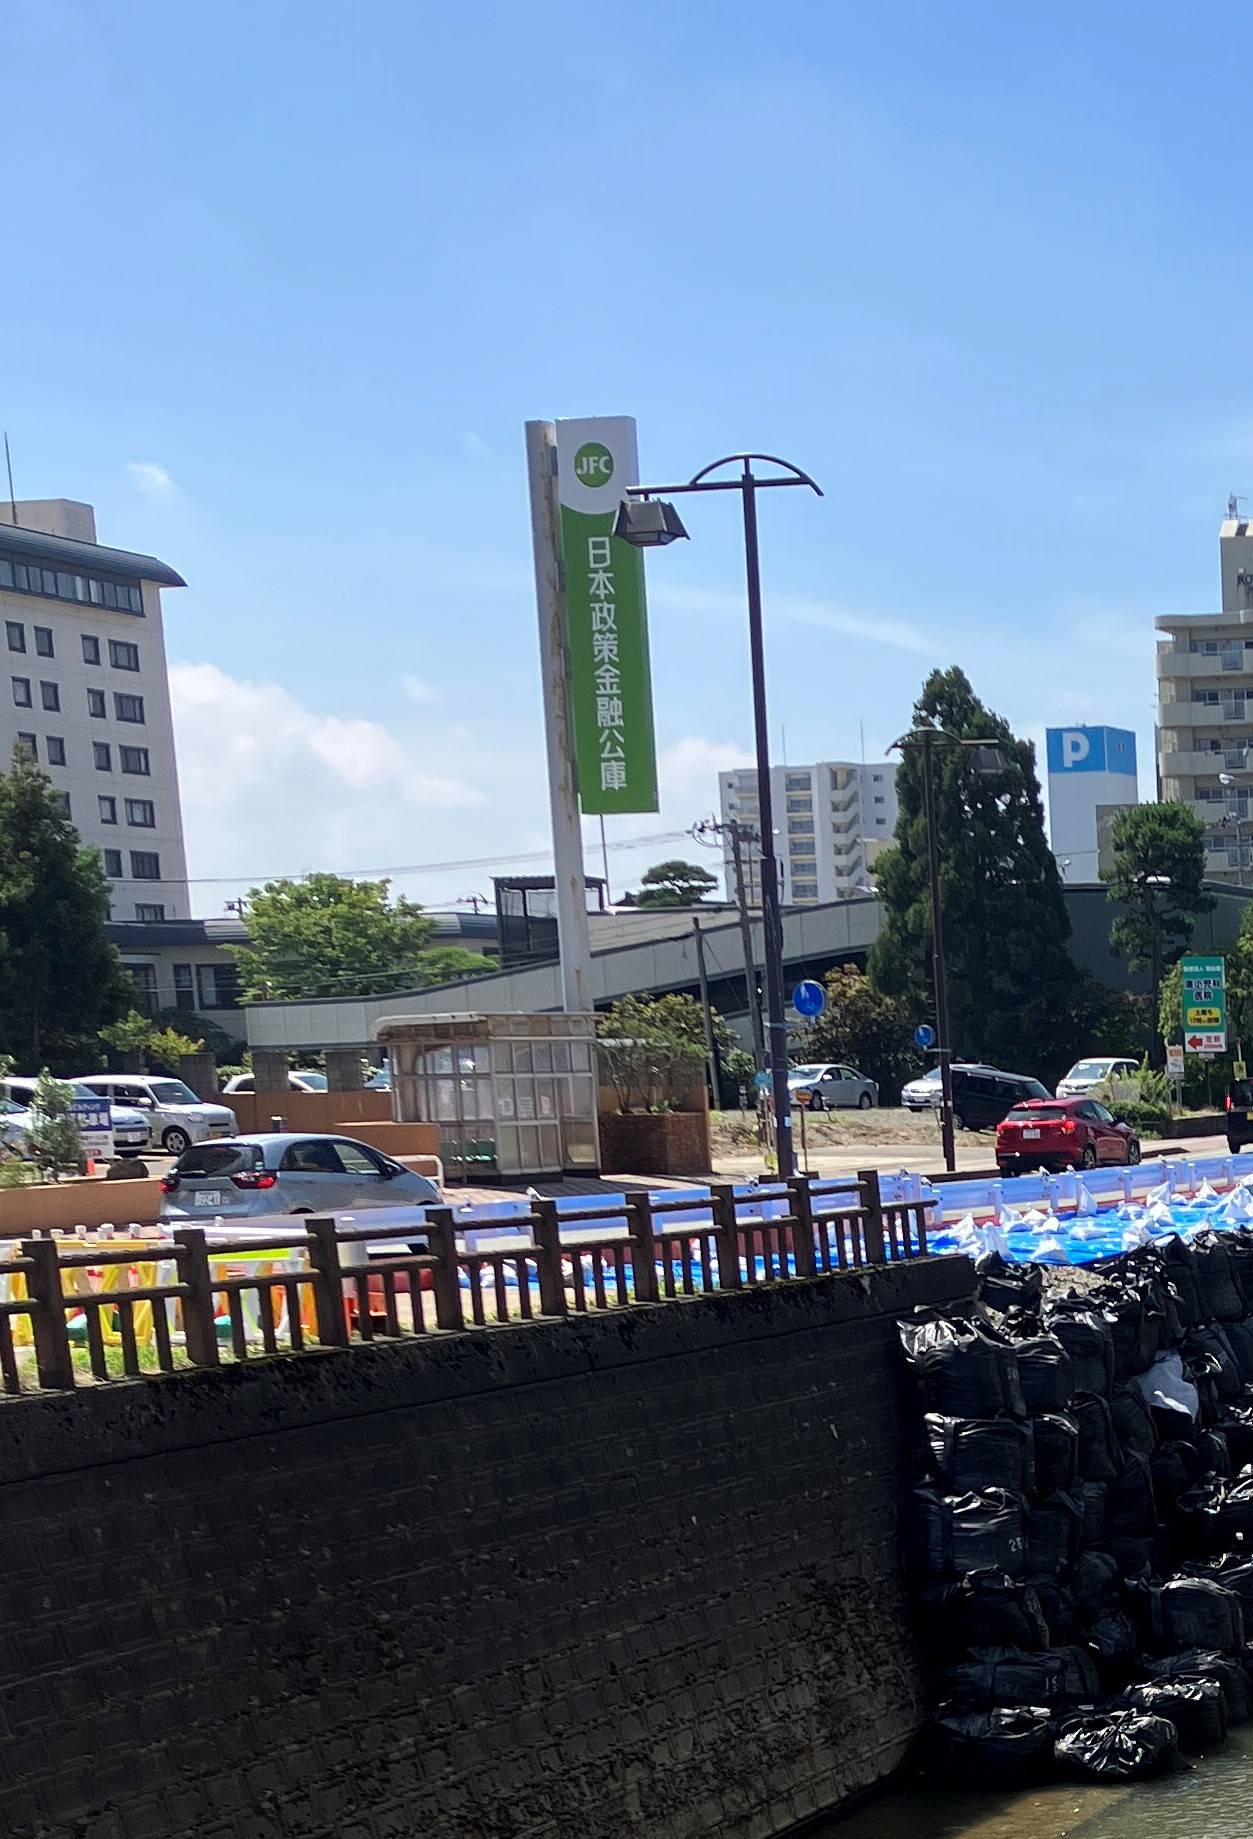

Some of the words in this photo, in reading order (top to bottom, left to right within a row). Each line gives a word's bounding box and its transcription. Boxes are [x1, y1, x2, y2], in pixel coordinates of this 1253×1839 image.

[576, 455, 611, 475] JFC
[587, 536, 628, 792] 日本政策金融公庫
[1062, 732, 1090, 768] P
